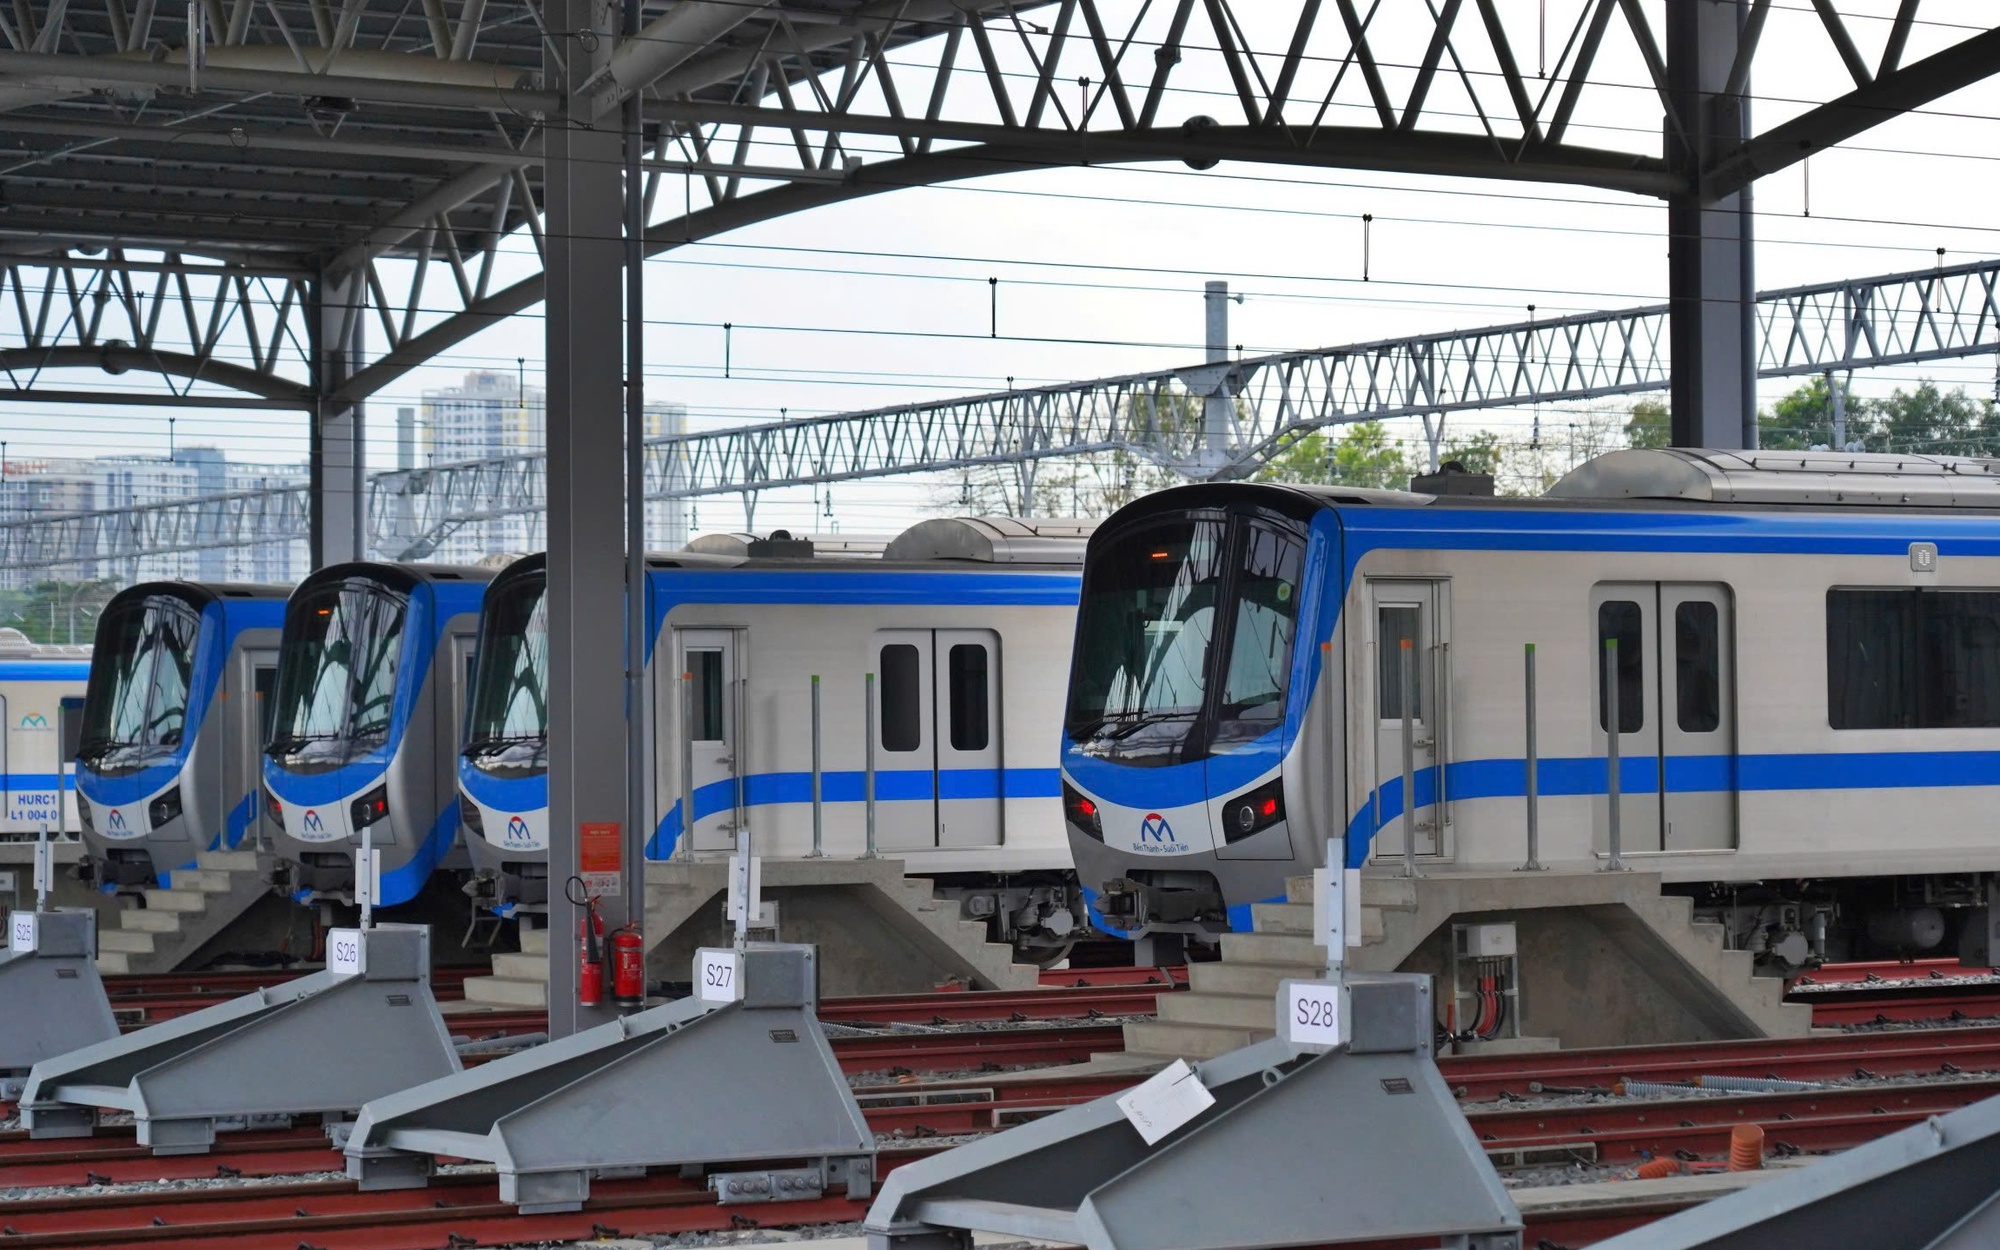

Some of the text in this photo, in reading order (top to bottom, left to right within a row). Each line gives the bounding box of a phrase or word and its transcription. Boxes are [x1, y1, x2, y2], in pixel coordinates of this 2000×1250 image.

[18, 794, 56, 805] HURC1
[11, 810, 23, 820] L1
[27, 810, 47, 820] 004
[16, 923, 31, 941] S25
[336, 941, 357, 963] S26
[706, 963, 732, 988] S27
[1297, 998, 1333, 1027] S28
